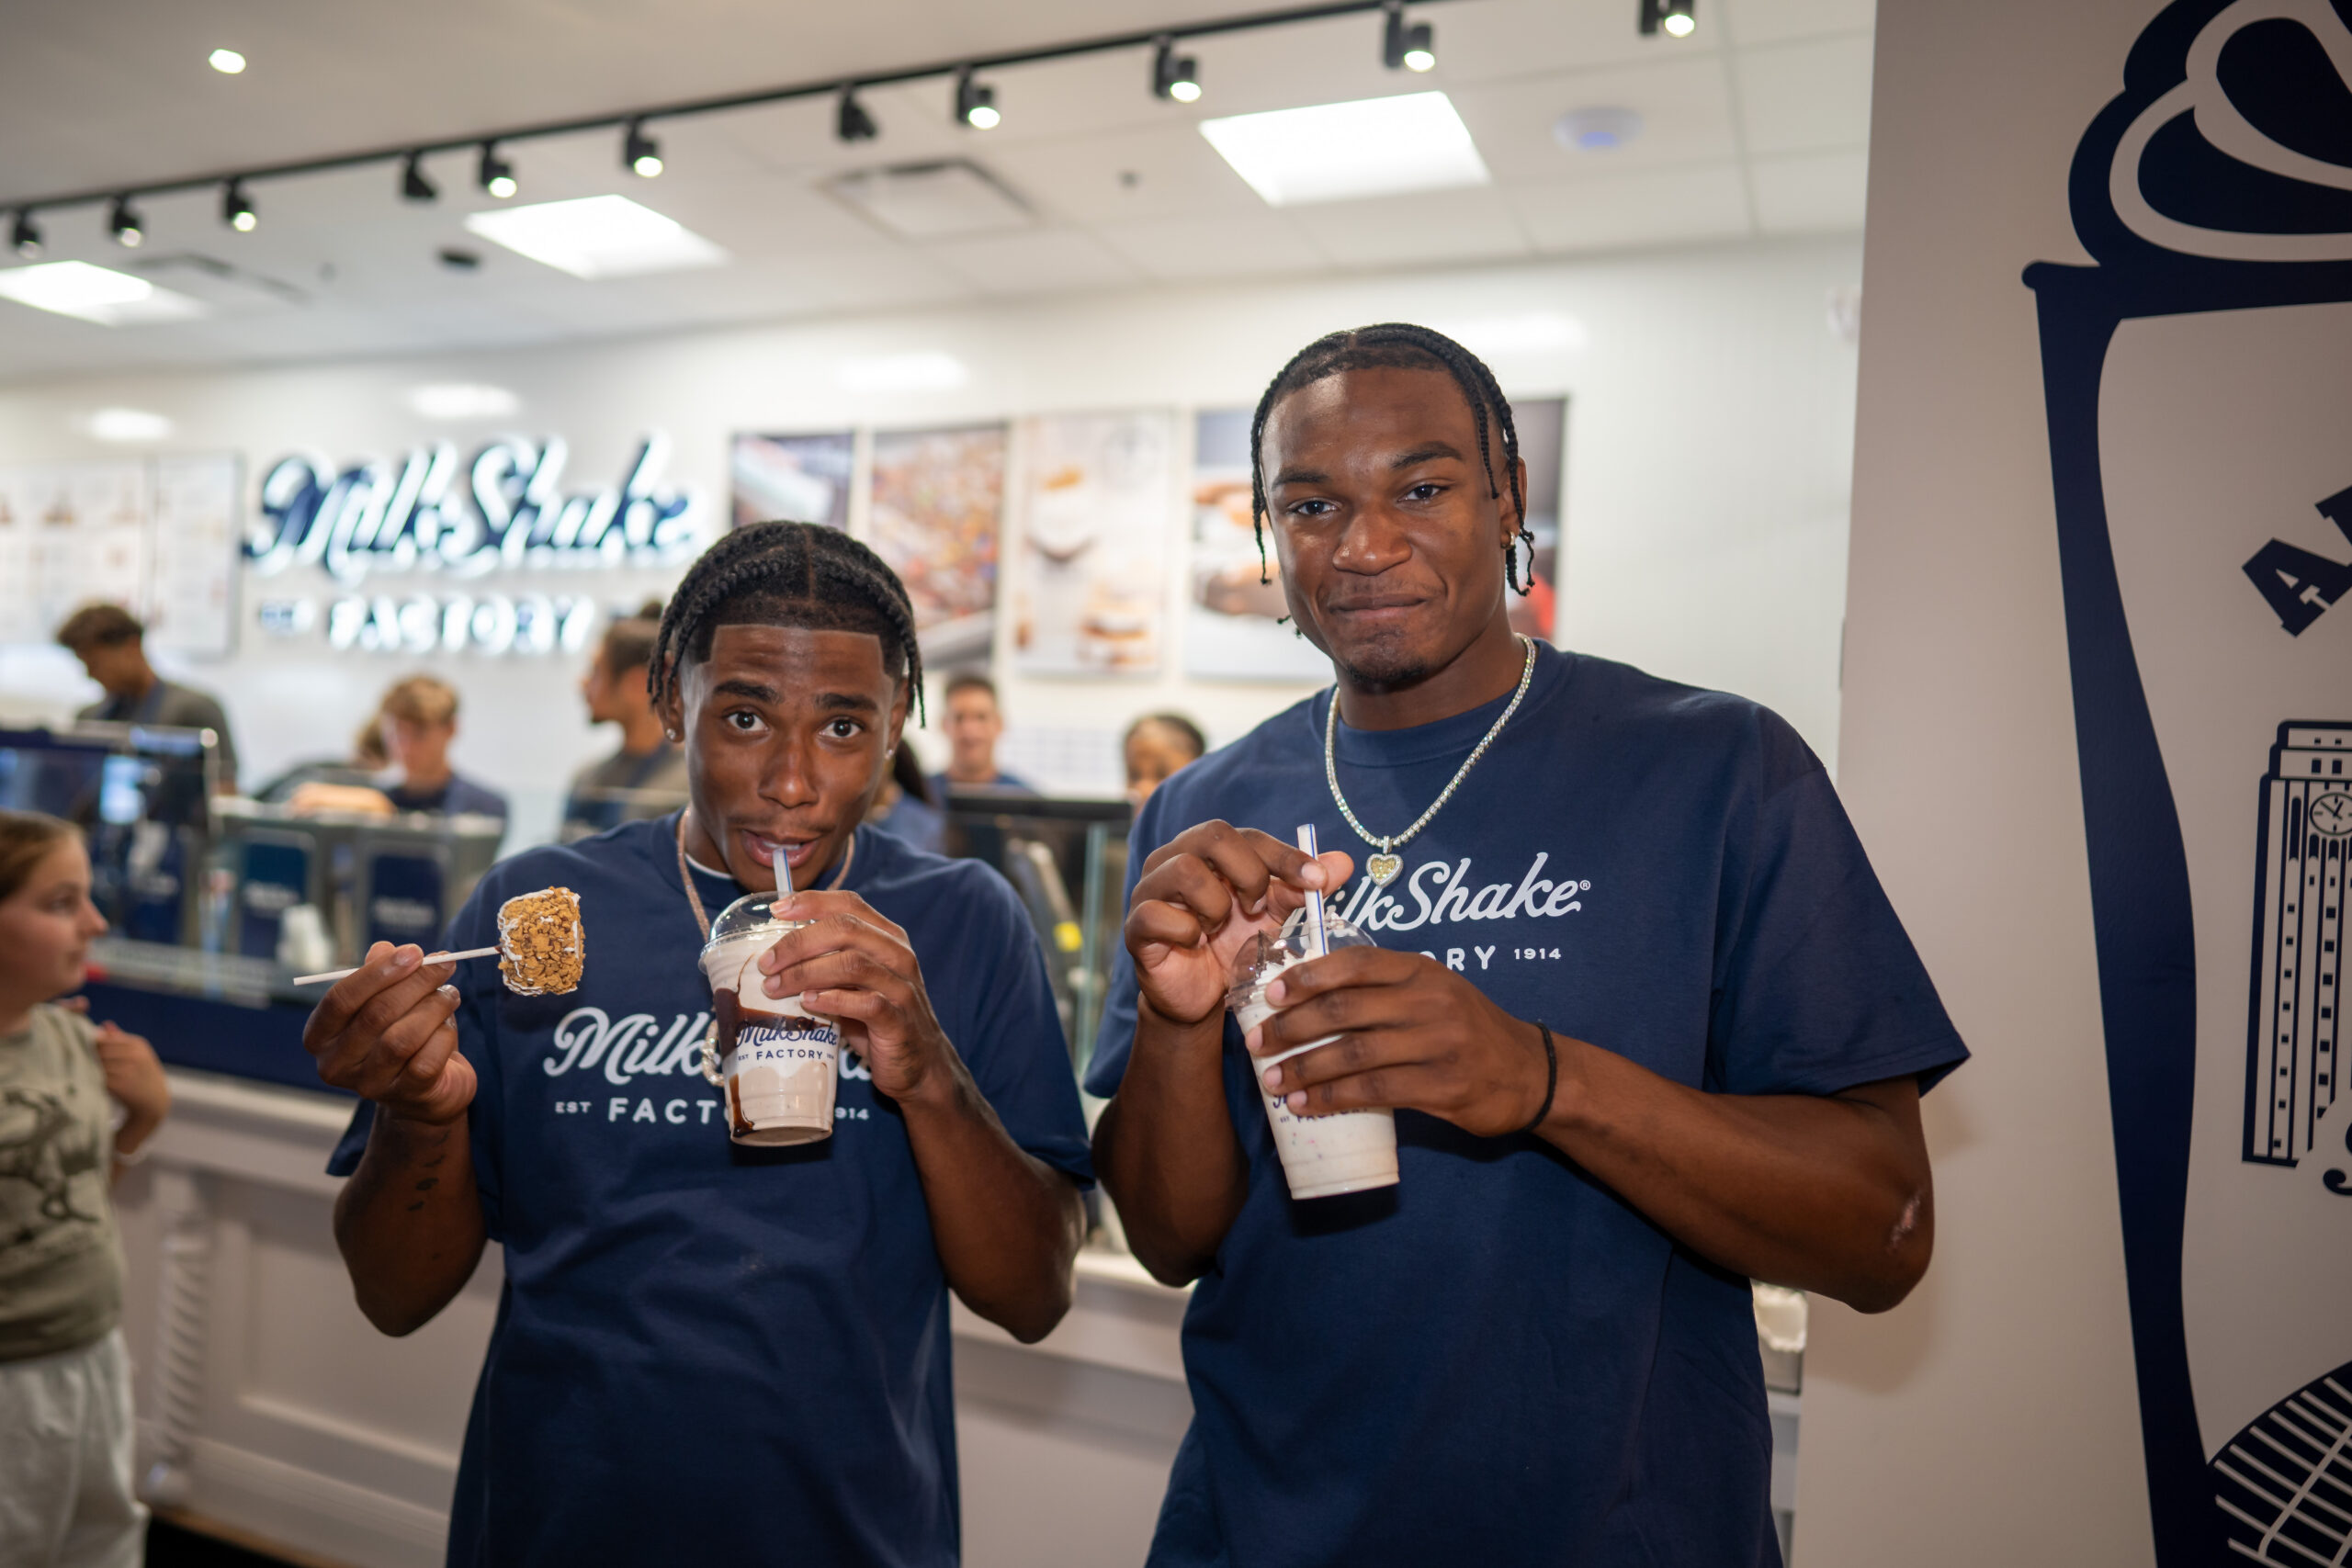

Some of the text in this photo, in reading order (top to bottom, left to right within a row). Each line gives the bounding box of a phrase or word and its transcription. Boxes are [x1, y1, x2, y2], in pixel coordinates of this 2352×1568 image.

[243, 432, 709, 588] MilkShake
[329, 593, 597, 652] FACTORY
[1514, 948, 1561, 960] 1914
[756, 1049, 822, 1060] FACTORY
[555, 1101, 591, 1113] EST
[834, 1107, 869, 1120] 914
